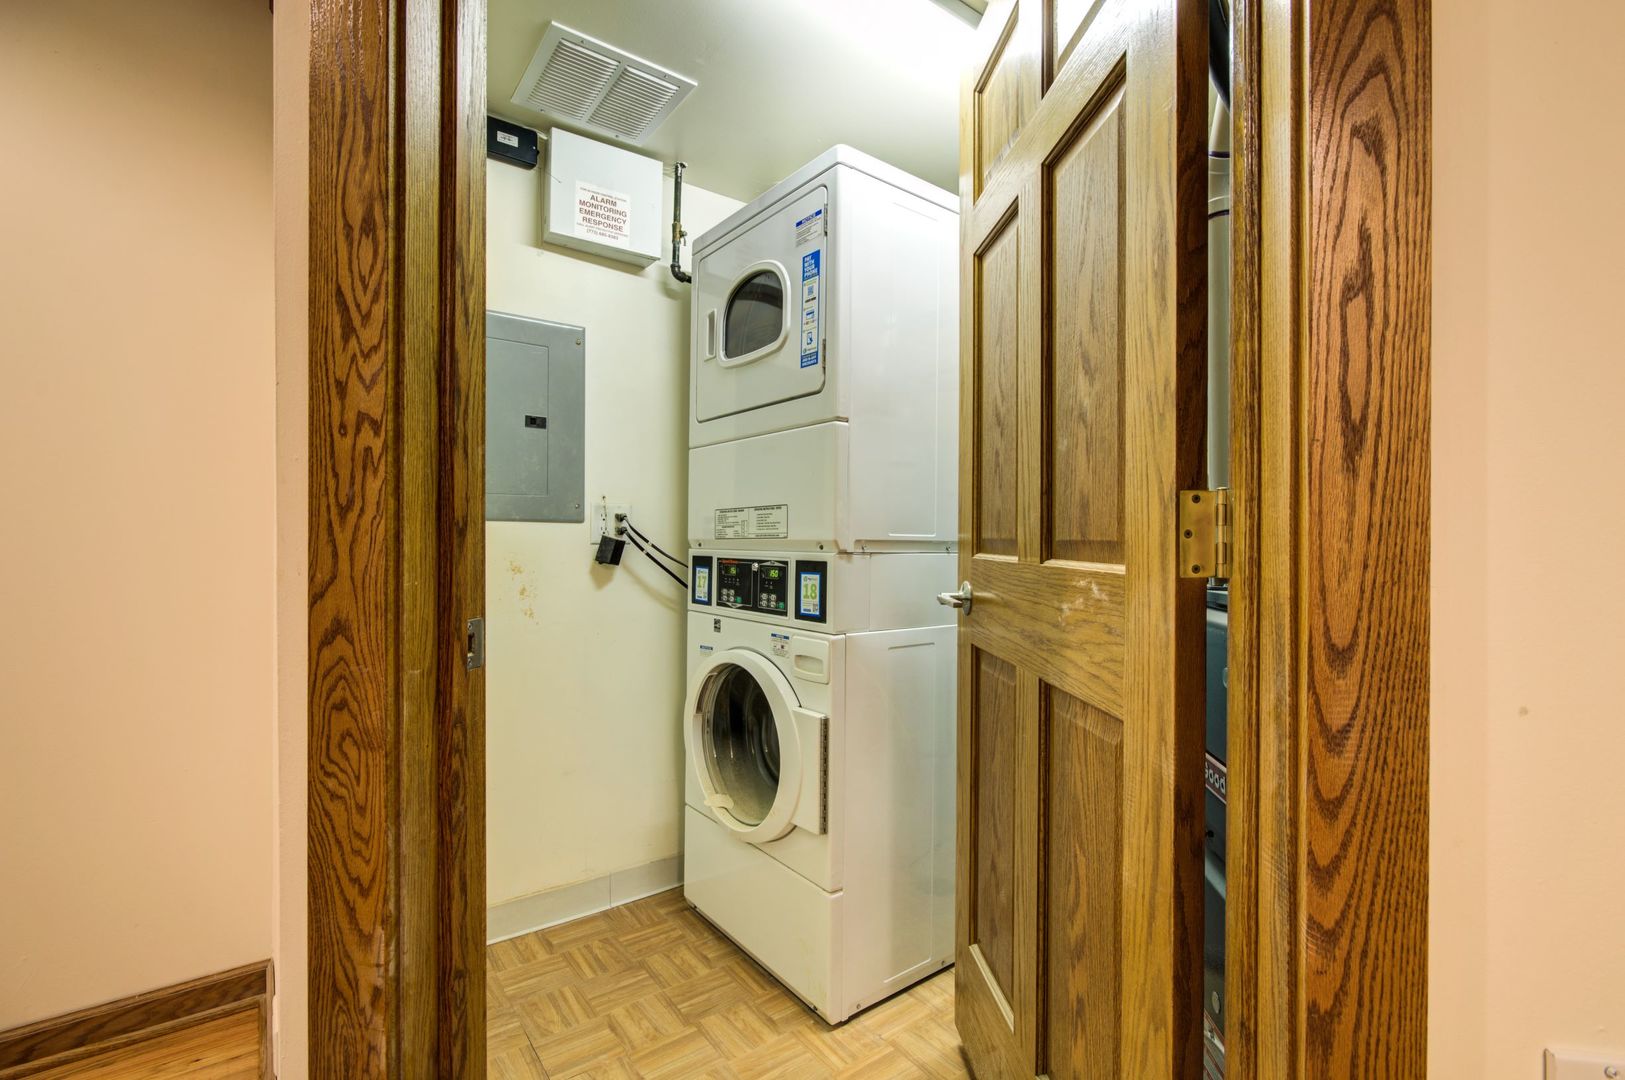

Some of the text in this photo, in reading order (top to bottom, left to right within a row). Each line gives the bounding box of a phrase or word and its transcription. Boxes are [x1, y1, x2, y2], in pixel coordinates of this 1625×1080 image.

[579, 199, 627, 218] MONITORING
[590, 194, 617, 208] ALARM
[579, 207, 627, 225] EMERGENCY
[582, 216, 624, 233] RESPONSE
[803, 583, 818, 600] 18
